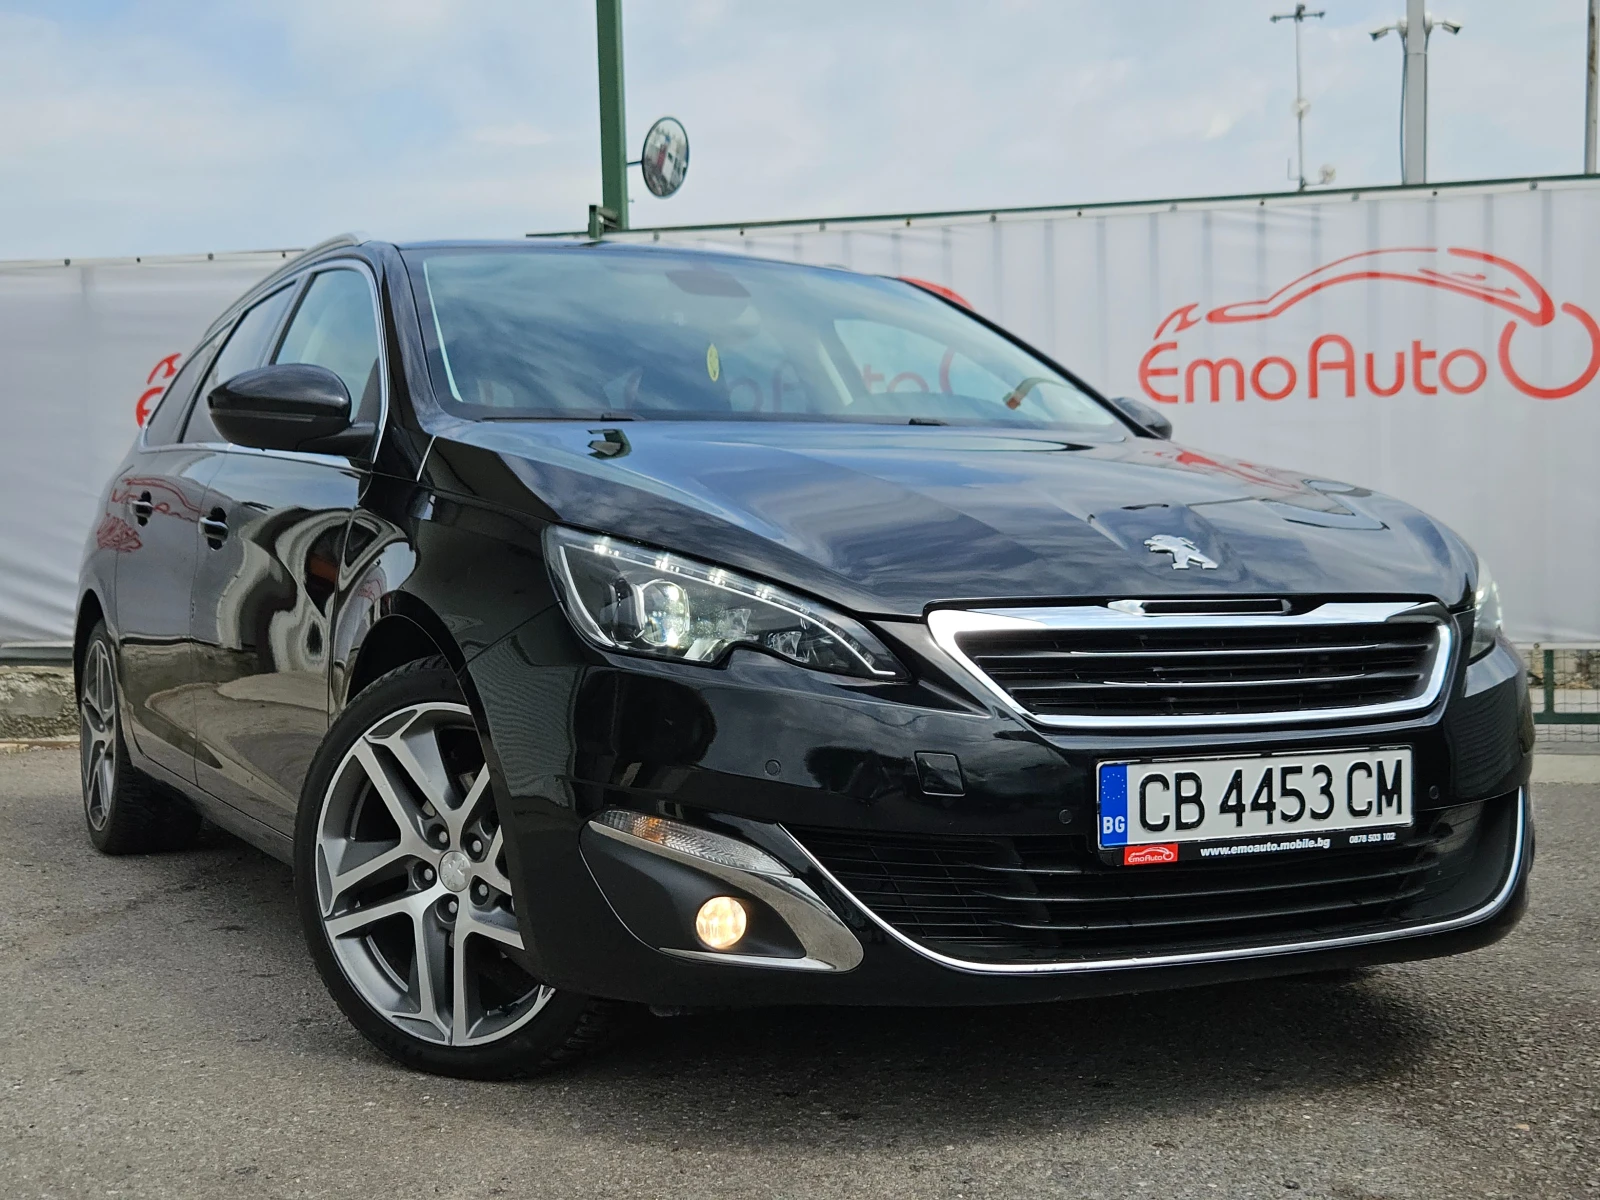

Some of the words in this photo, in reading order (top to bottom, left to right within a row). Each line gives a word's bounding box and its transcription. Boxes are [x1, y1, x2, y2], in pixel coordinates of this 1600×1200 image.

[1138, 333, 1488, 404] EmoAuto
[1139, 771, 1205, 832] CB
[1219, 764, 1335, 828] 4453
[1347, 758, 1403, 818] CM
[1102, 816, 1126, 834] BG
[1382, 832, 1396, 841] 102
[1200, 837, 1330, 857] www.emoauto.mobile.bg
[1128, 854, 1163, 863] EmoAuto
